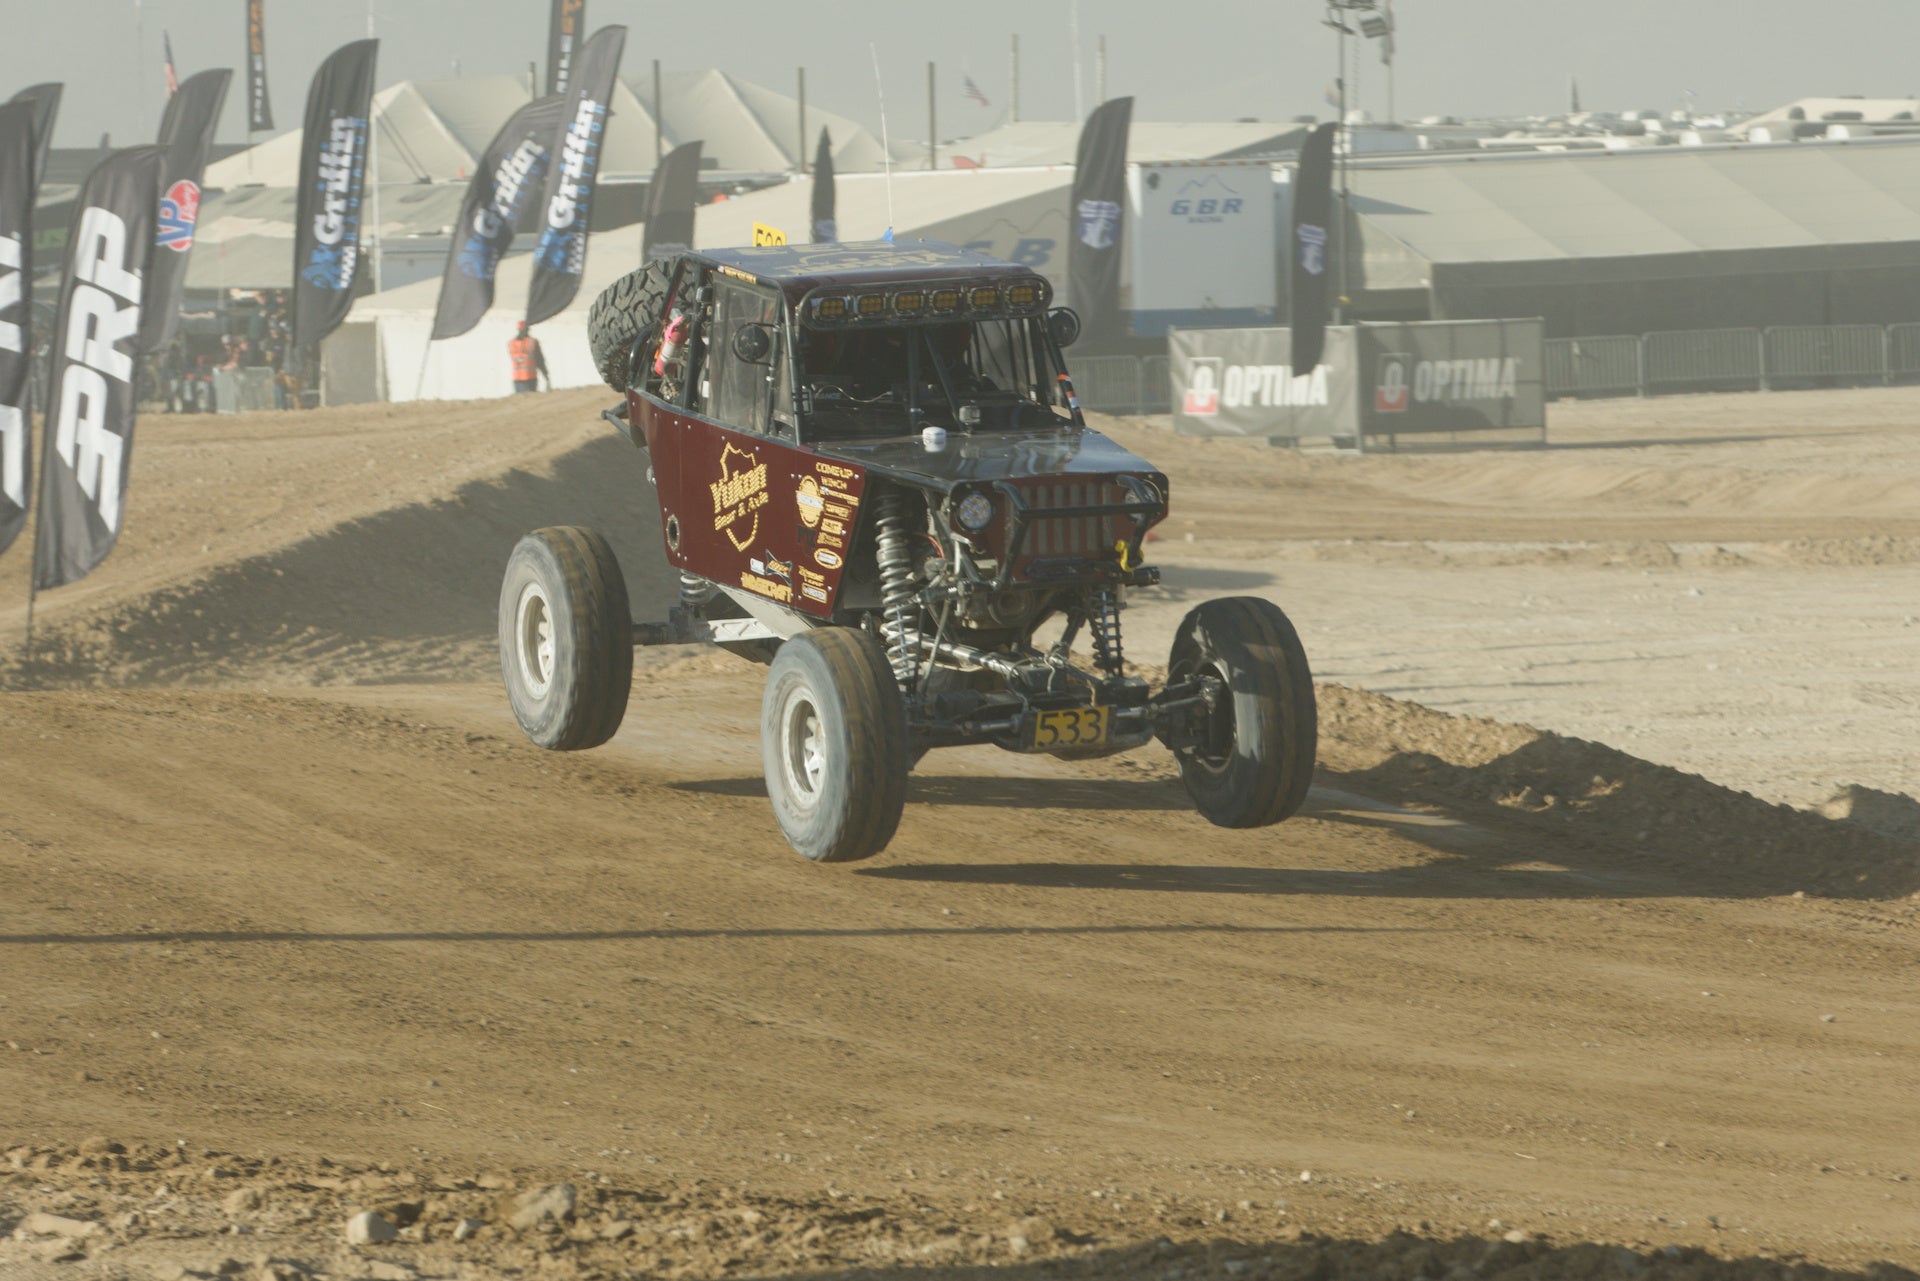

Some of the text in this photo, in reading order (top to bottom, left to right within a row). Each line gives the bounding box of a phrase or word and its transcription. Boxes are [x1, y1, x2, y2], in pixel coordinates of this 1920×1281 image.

[313, 116, 357, 245] Griffin
[549, 98, 597, 229] Griffin
[474, 138, 545, 239] Griffin
[1169, 198, 1243, 215] GBR
[155, 198, 195, 246] VP
[57, 206, 142, 535] PRP
[1223, 364, 1329, 406] OPTIMA
[1414, 358, 1517, 402] OPTIMA
[709, 463, 768, 514] Yukon
[1038, 709, 1102, 747] 533
